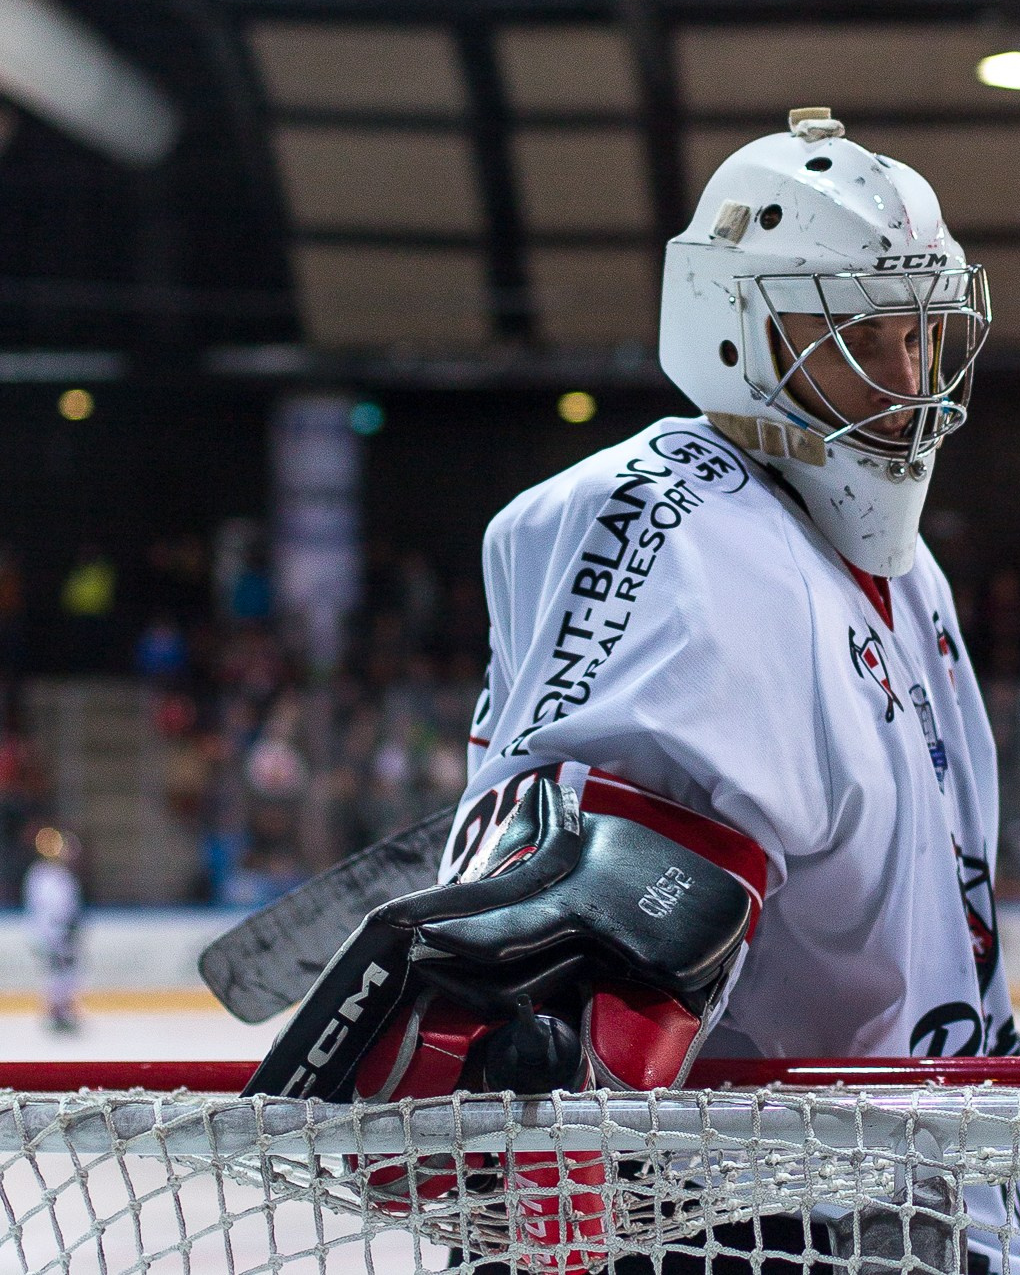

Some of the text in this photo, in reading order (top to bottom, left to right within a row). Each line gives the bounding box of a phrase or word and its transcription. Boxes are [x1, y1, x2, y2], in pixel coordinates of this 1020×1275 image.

[872, 253, 948, 271] CCM
[553, 479, 704, 723] TURAL RESORT
